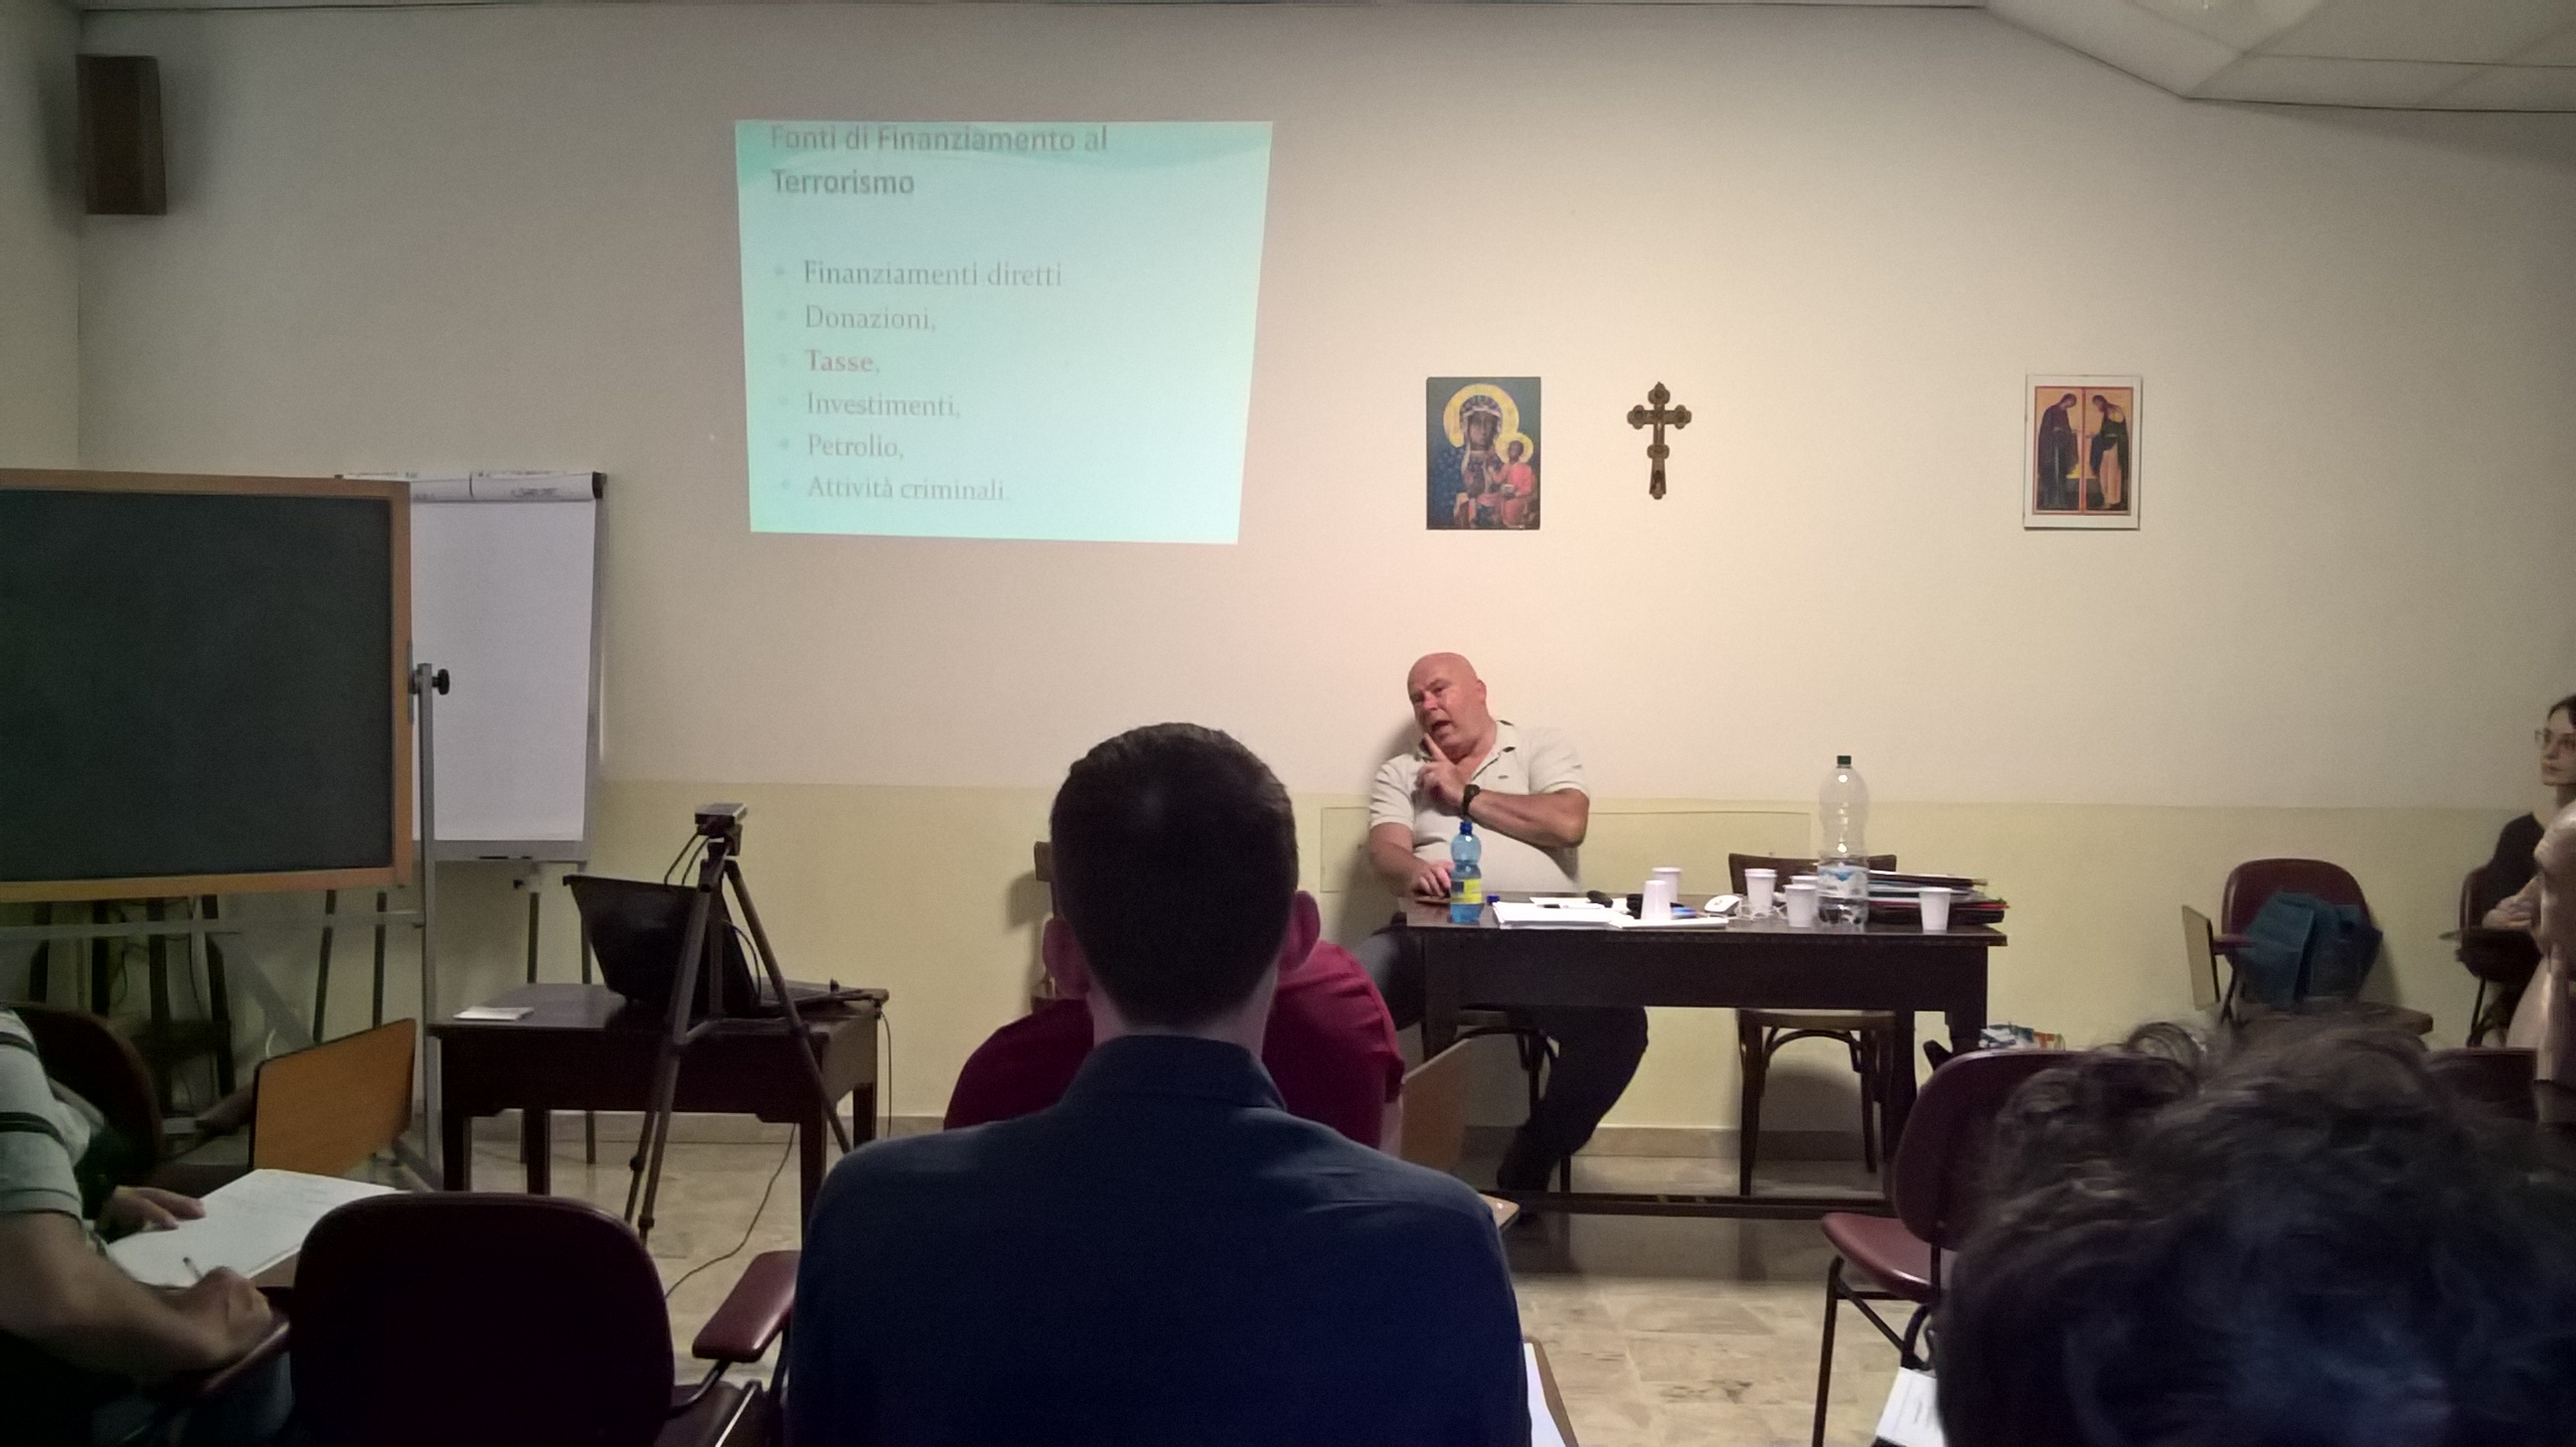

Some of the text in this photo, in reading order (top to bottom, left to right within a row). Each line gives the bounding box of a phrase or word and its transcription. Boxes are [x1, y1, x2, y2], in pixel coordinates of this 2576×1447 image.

[770, 124, 1108, 151] Fonti di Finanziamento al
[771, 169, 914, 195] Terrorismo
[803, 259, 1062, 287] Finanziamenti diretti
[805, 304, 937, 333] Donazioni,
[807, 391, 961, 419] Investimenti,
[808, 432, 904, 460] Petrolio,
[808, 474, 893, 499] Attività
